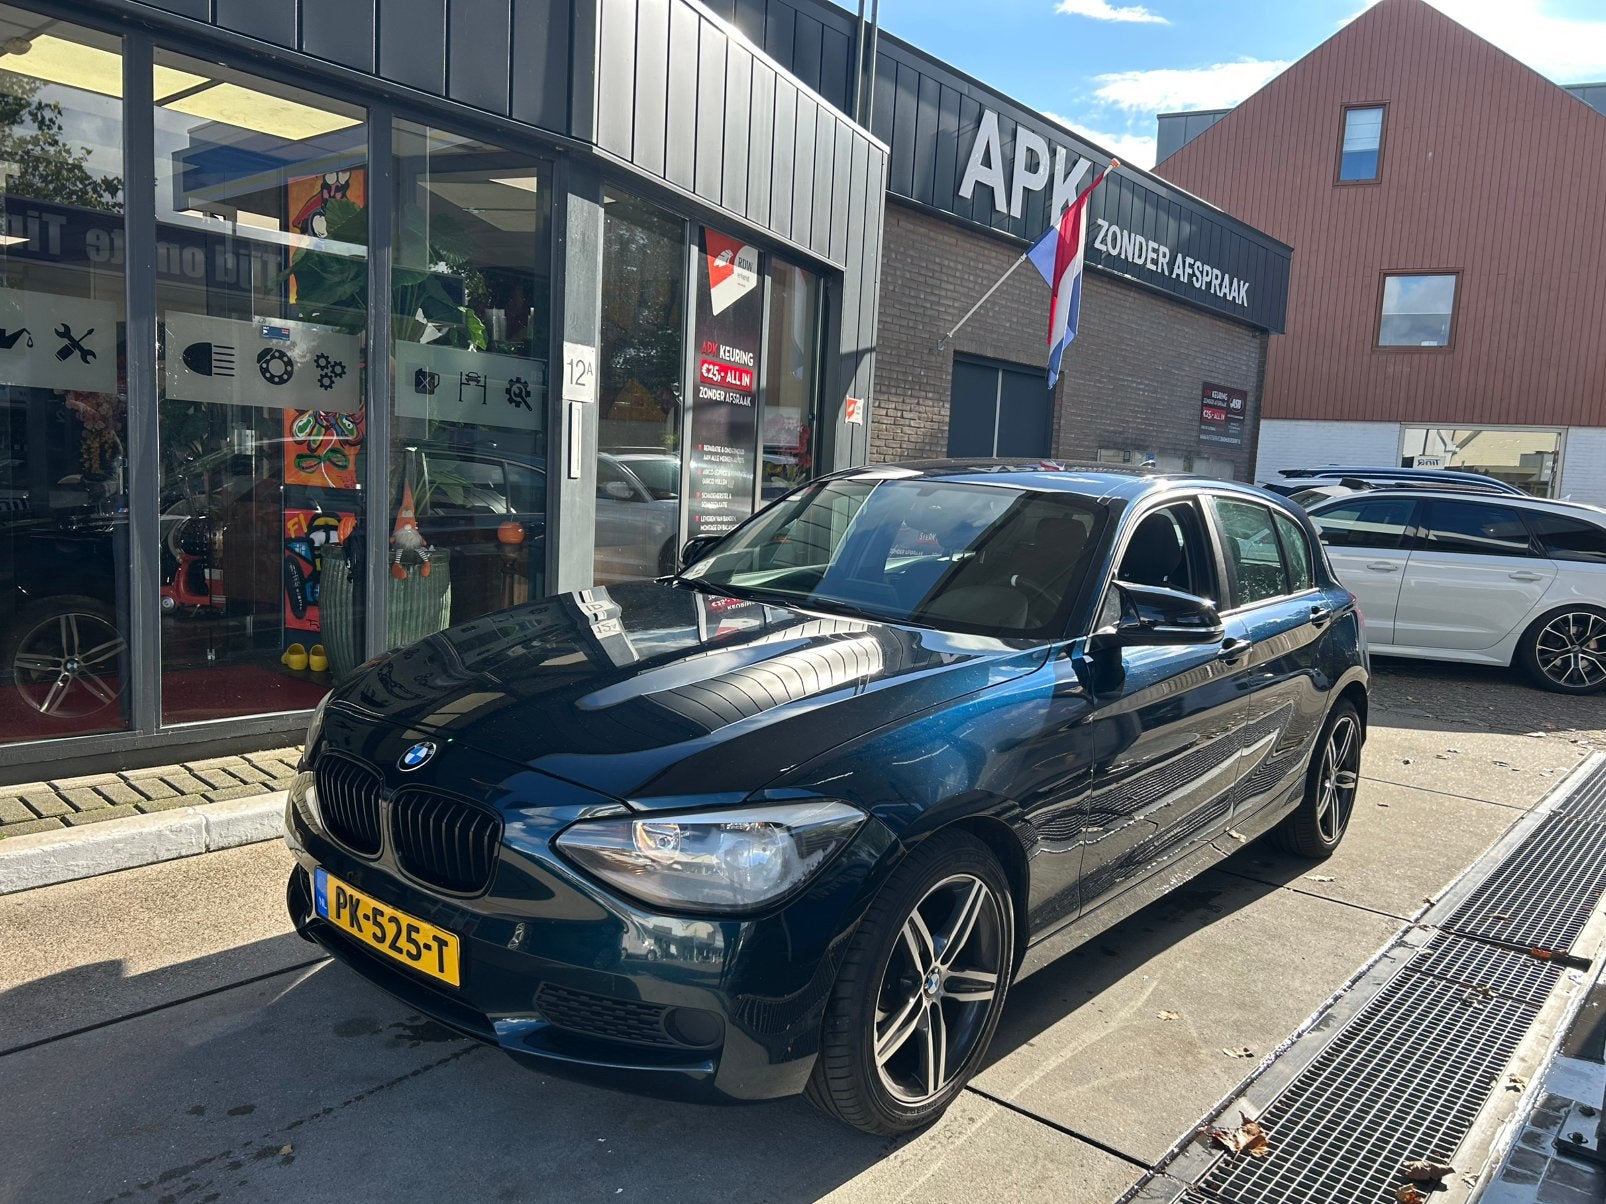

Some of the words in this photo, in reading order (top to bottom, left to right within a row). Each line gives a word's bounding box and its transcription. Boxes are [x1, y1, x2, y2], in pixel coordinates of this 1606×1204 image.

[958, 109, 1092, 226] APK
[738, 257, 755, 272] RDW
[1094, 218, 1170, 276] ZONDER
[1171, 253, 1250, 307] AFSPRAAK
[702, 341, 718, 357] APK
[720, 344, 754, 366] KEURING
[566, 358, 594, 386] 12A
[726, 370, 741, 385] ALL
[742, 373, 751, 386] IN
[699, 387, 725, 401] ZONDER
[318, 897, 327, 910] NL
[335, 885, 449, 974] PK-525-T
